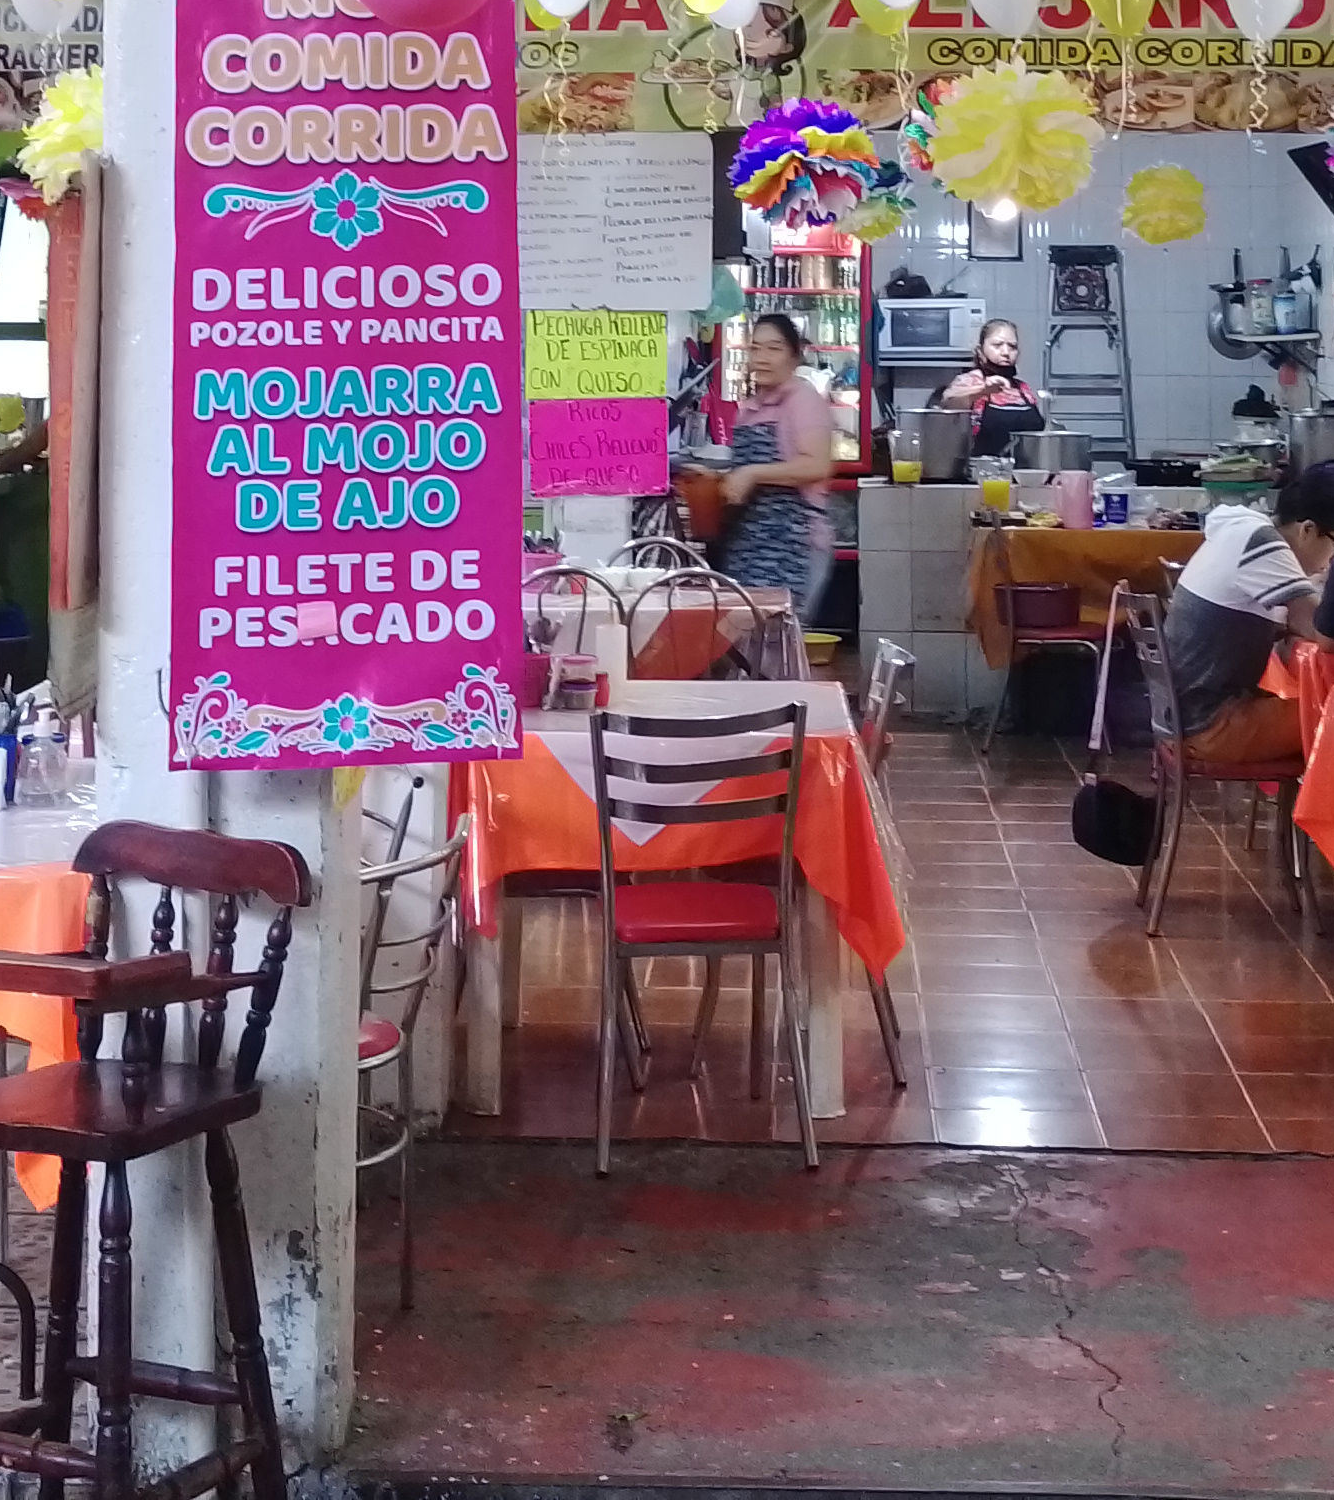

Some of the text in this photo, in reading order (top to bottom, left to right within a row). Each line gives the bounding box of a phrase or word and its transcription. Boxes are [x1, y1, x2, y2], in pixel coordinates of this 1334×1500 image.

[201, 32, 493, 96] COMIDA
[927, 37, 1123, 66] COMIDA
[184, 105, 510, 167] CORRIDA
[190, 264, 504, 313] DELICIOSO
[190, 316, 505, 348] POZOLE Y PANCITA
[531, 309, 603, 337] PECHUGA
[546, 338, 659, 362] DE ESPINACA
[194, 364, 503, 422] MOJARRA
[529, 367, 643, 395] CON QUESO
[568, 400, 622, 422] RICOS
[208, 418, 487, 478] AL MOJO
[530, 432, 592, 461] CHILES
[235, 474, 462, 534] DE AJO
[213, 549, 481, 597] FILETE DE
